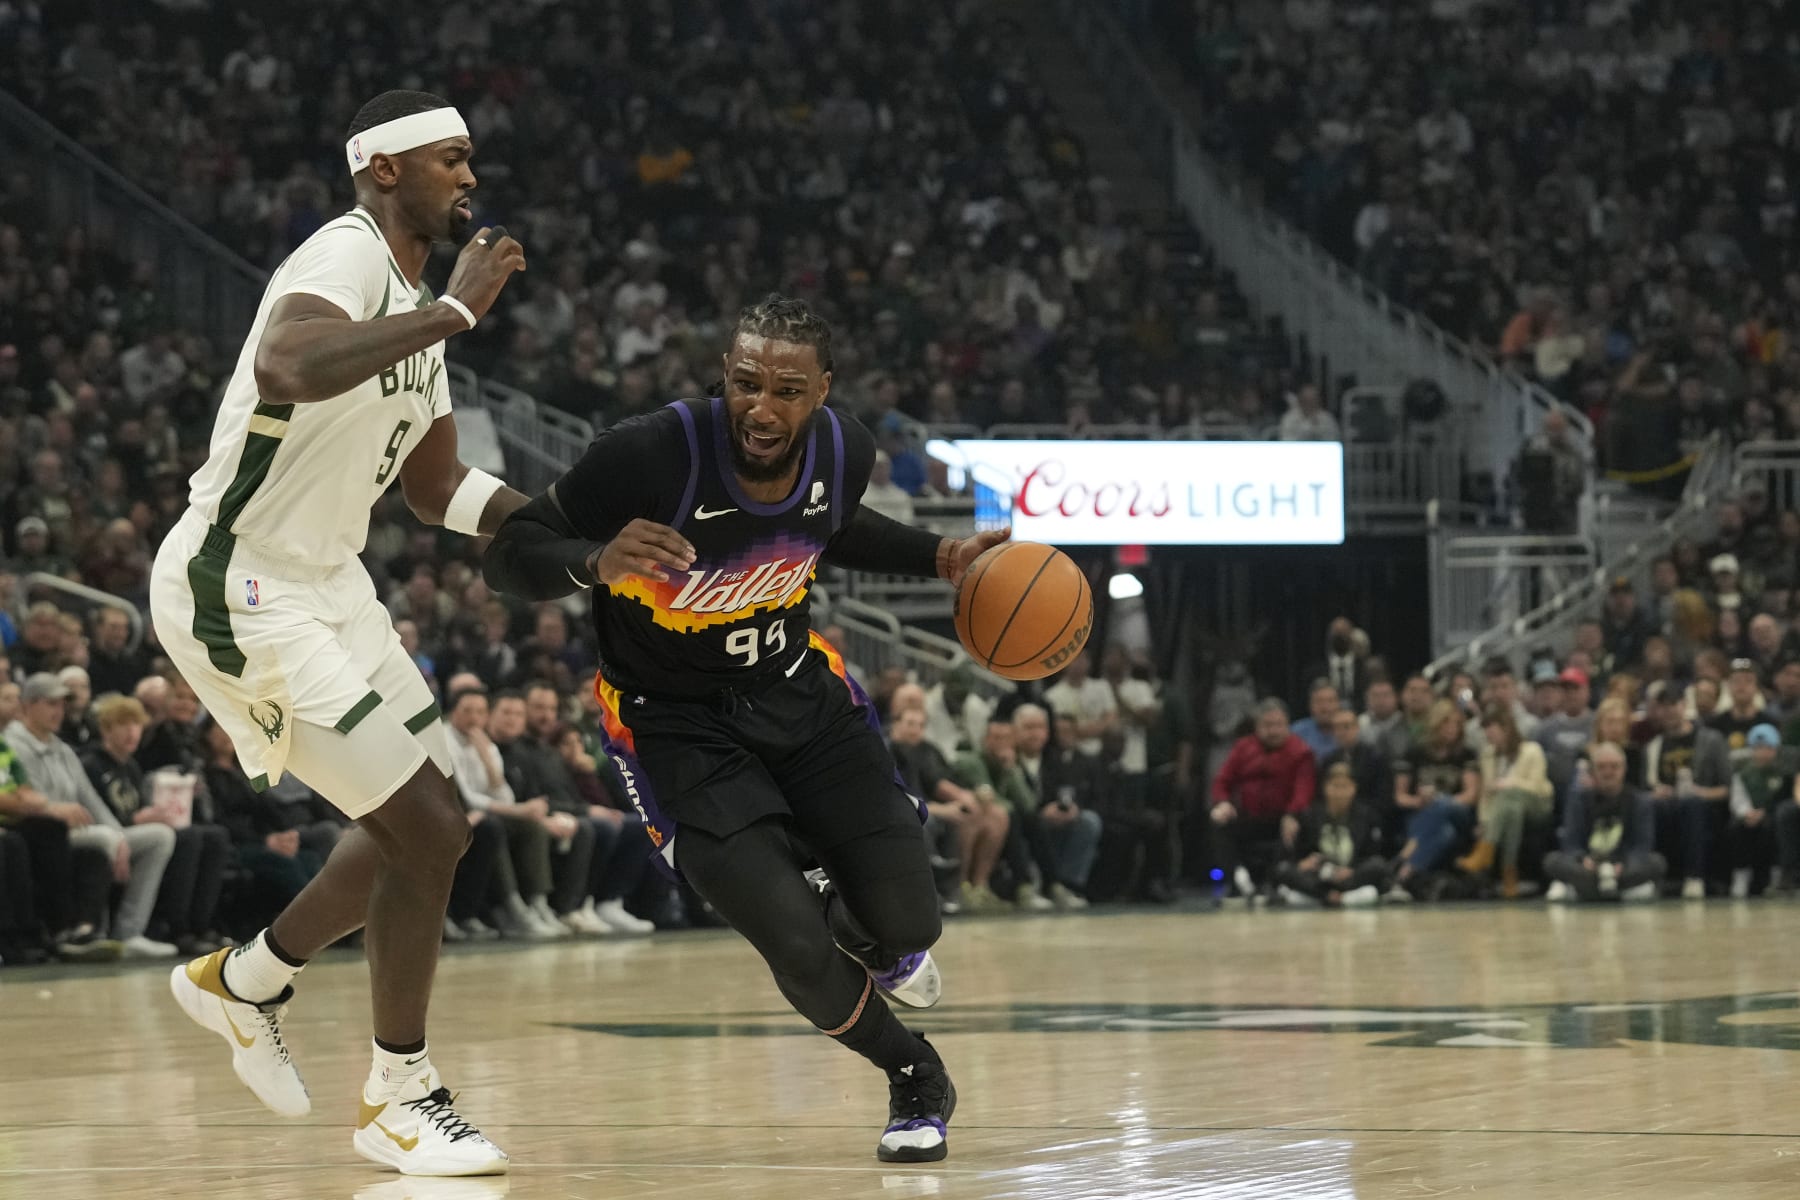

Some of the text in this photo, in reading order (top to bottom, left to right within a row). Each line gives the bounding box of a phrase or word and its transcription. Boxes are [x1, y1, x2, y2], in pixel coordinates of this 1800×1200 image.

[379, 350, 442, 417] BUCK
[375, 419, 412, 485] 9
[802, 502, 829, 517] PayPal
[1015, 458, 1326, 518] Coors LIGHT
[668, 552, 816, 613] Valley
[719, 570, 750, 584] THE
[726, 618, 787, 667] 99
